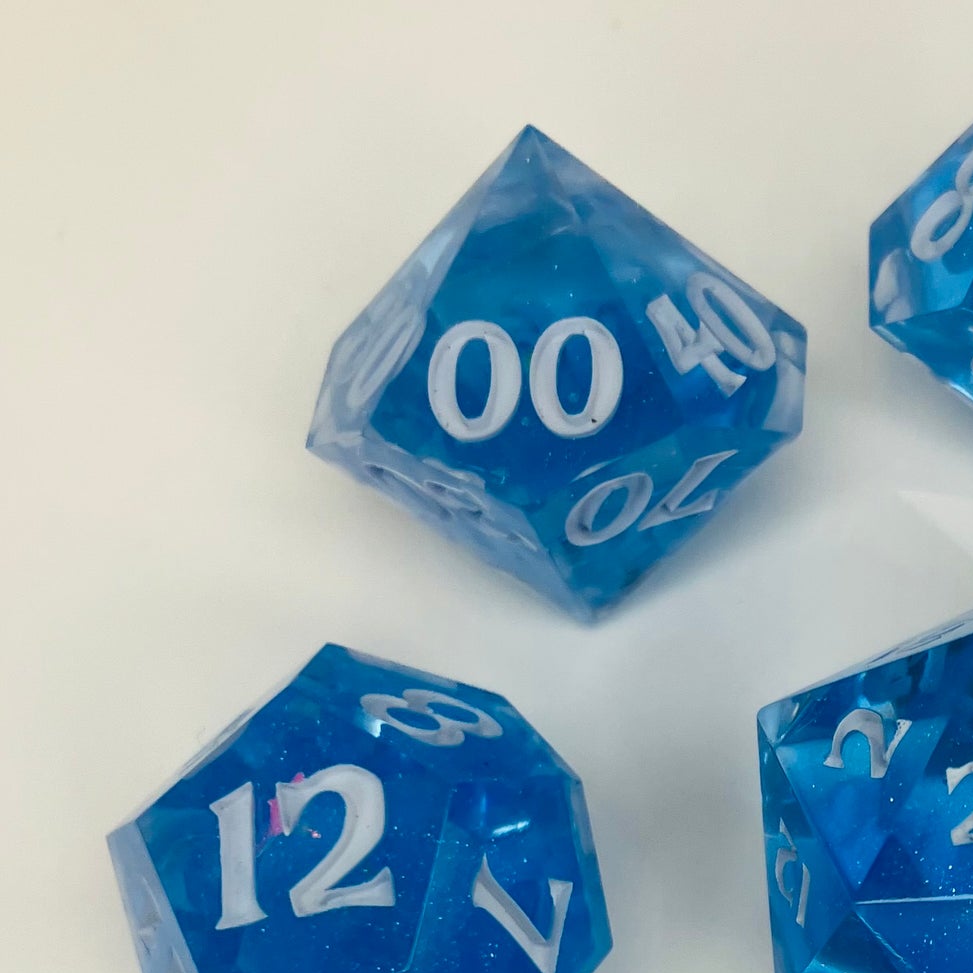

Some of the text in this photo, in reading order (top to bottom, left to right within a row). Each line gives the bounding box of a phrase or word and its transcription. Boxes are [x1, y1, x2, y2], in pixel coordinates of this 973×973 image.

[428, 316, 623, 442] 00
[645, 271, 776, 397] 40
[565, 449, 738, 547] 70
[359, 689, 504, 747] 8
[823, 708, 913, 779] 2
[209, 764, 396, 930] 12
